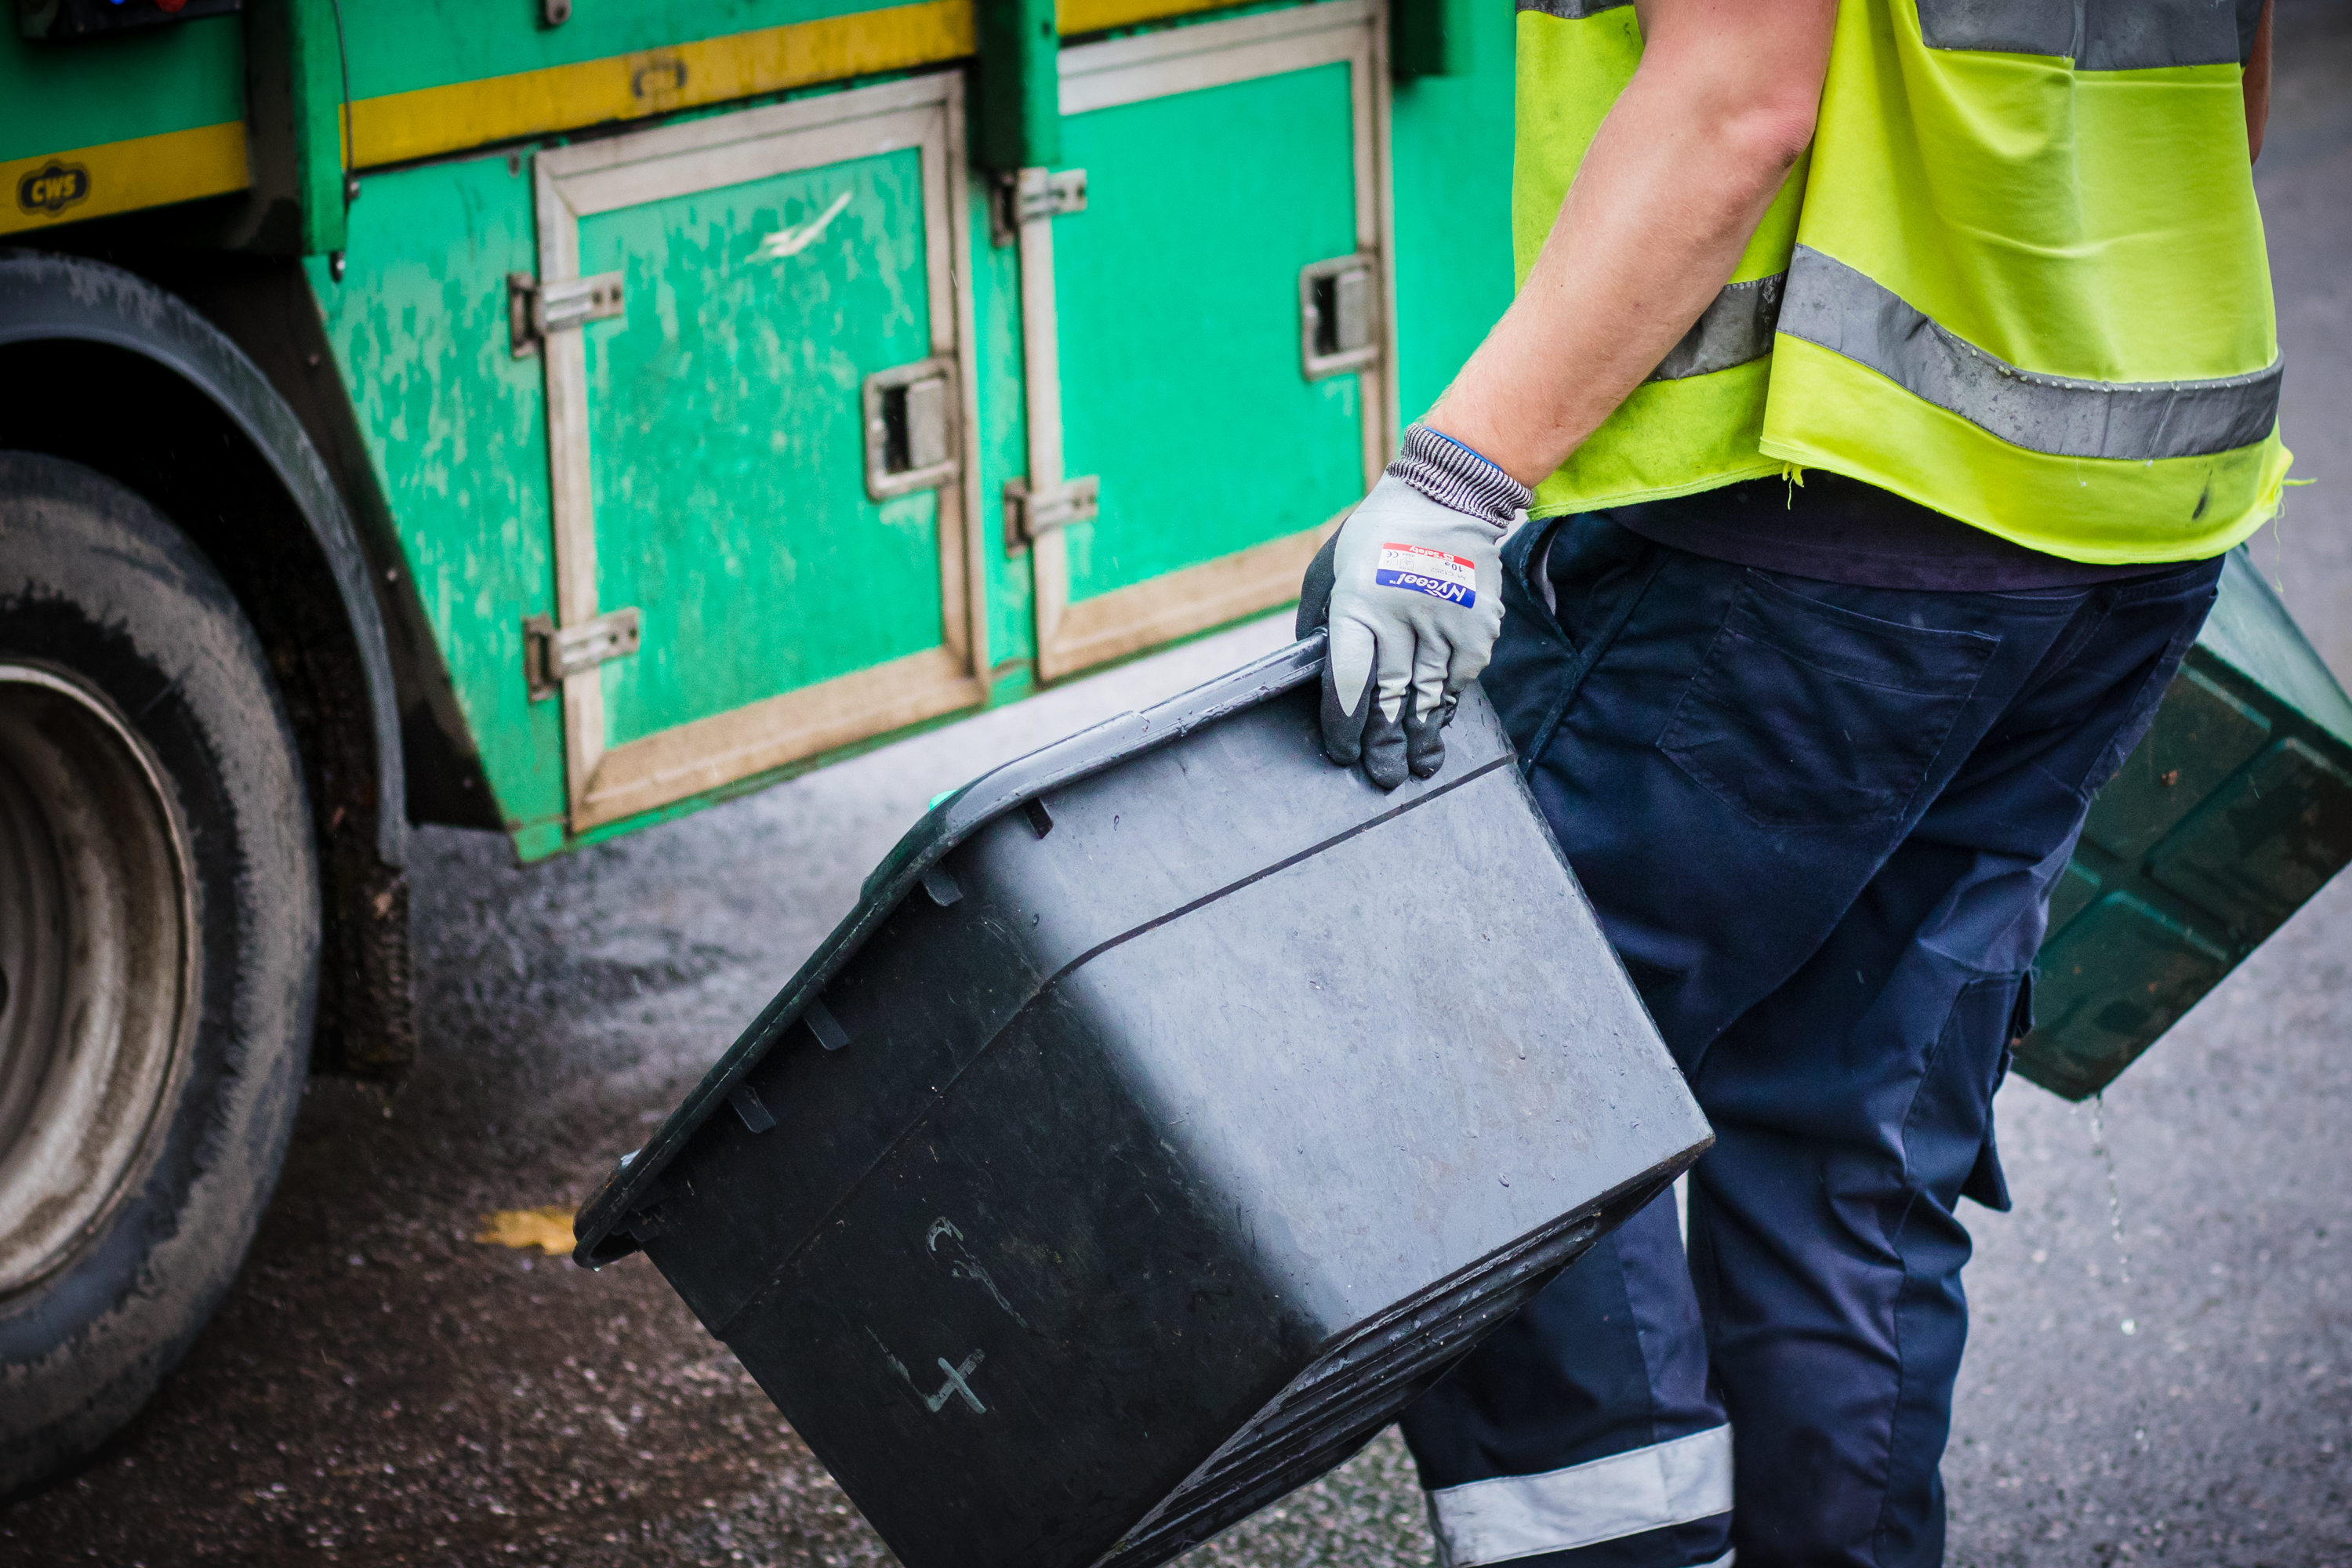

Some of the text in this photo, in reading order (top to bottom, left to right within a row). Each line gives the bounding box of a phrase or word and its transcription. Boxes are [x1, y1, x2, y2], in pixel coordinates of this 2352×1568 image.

[31, 173, 76, 203] CWS
[1409, 546, 1440, 558] Safety
[1451, 563, 1464, 572] 10
